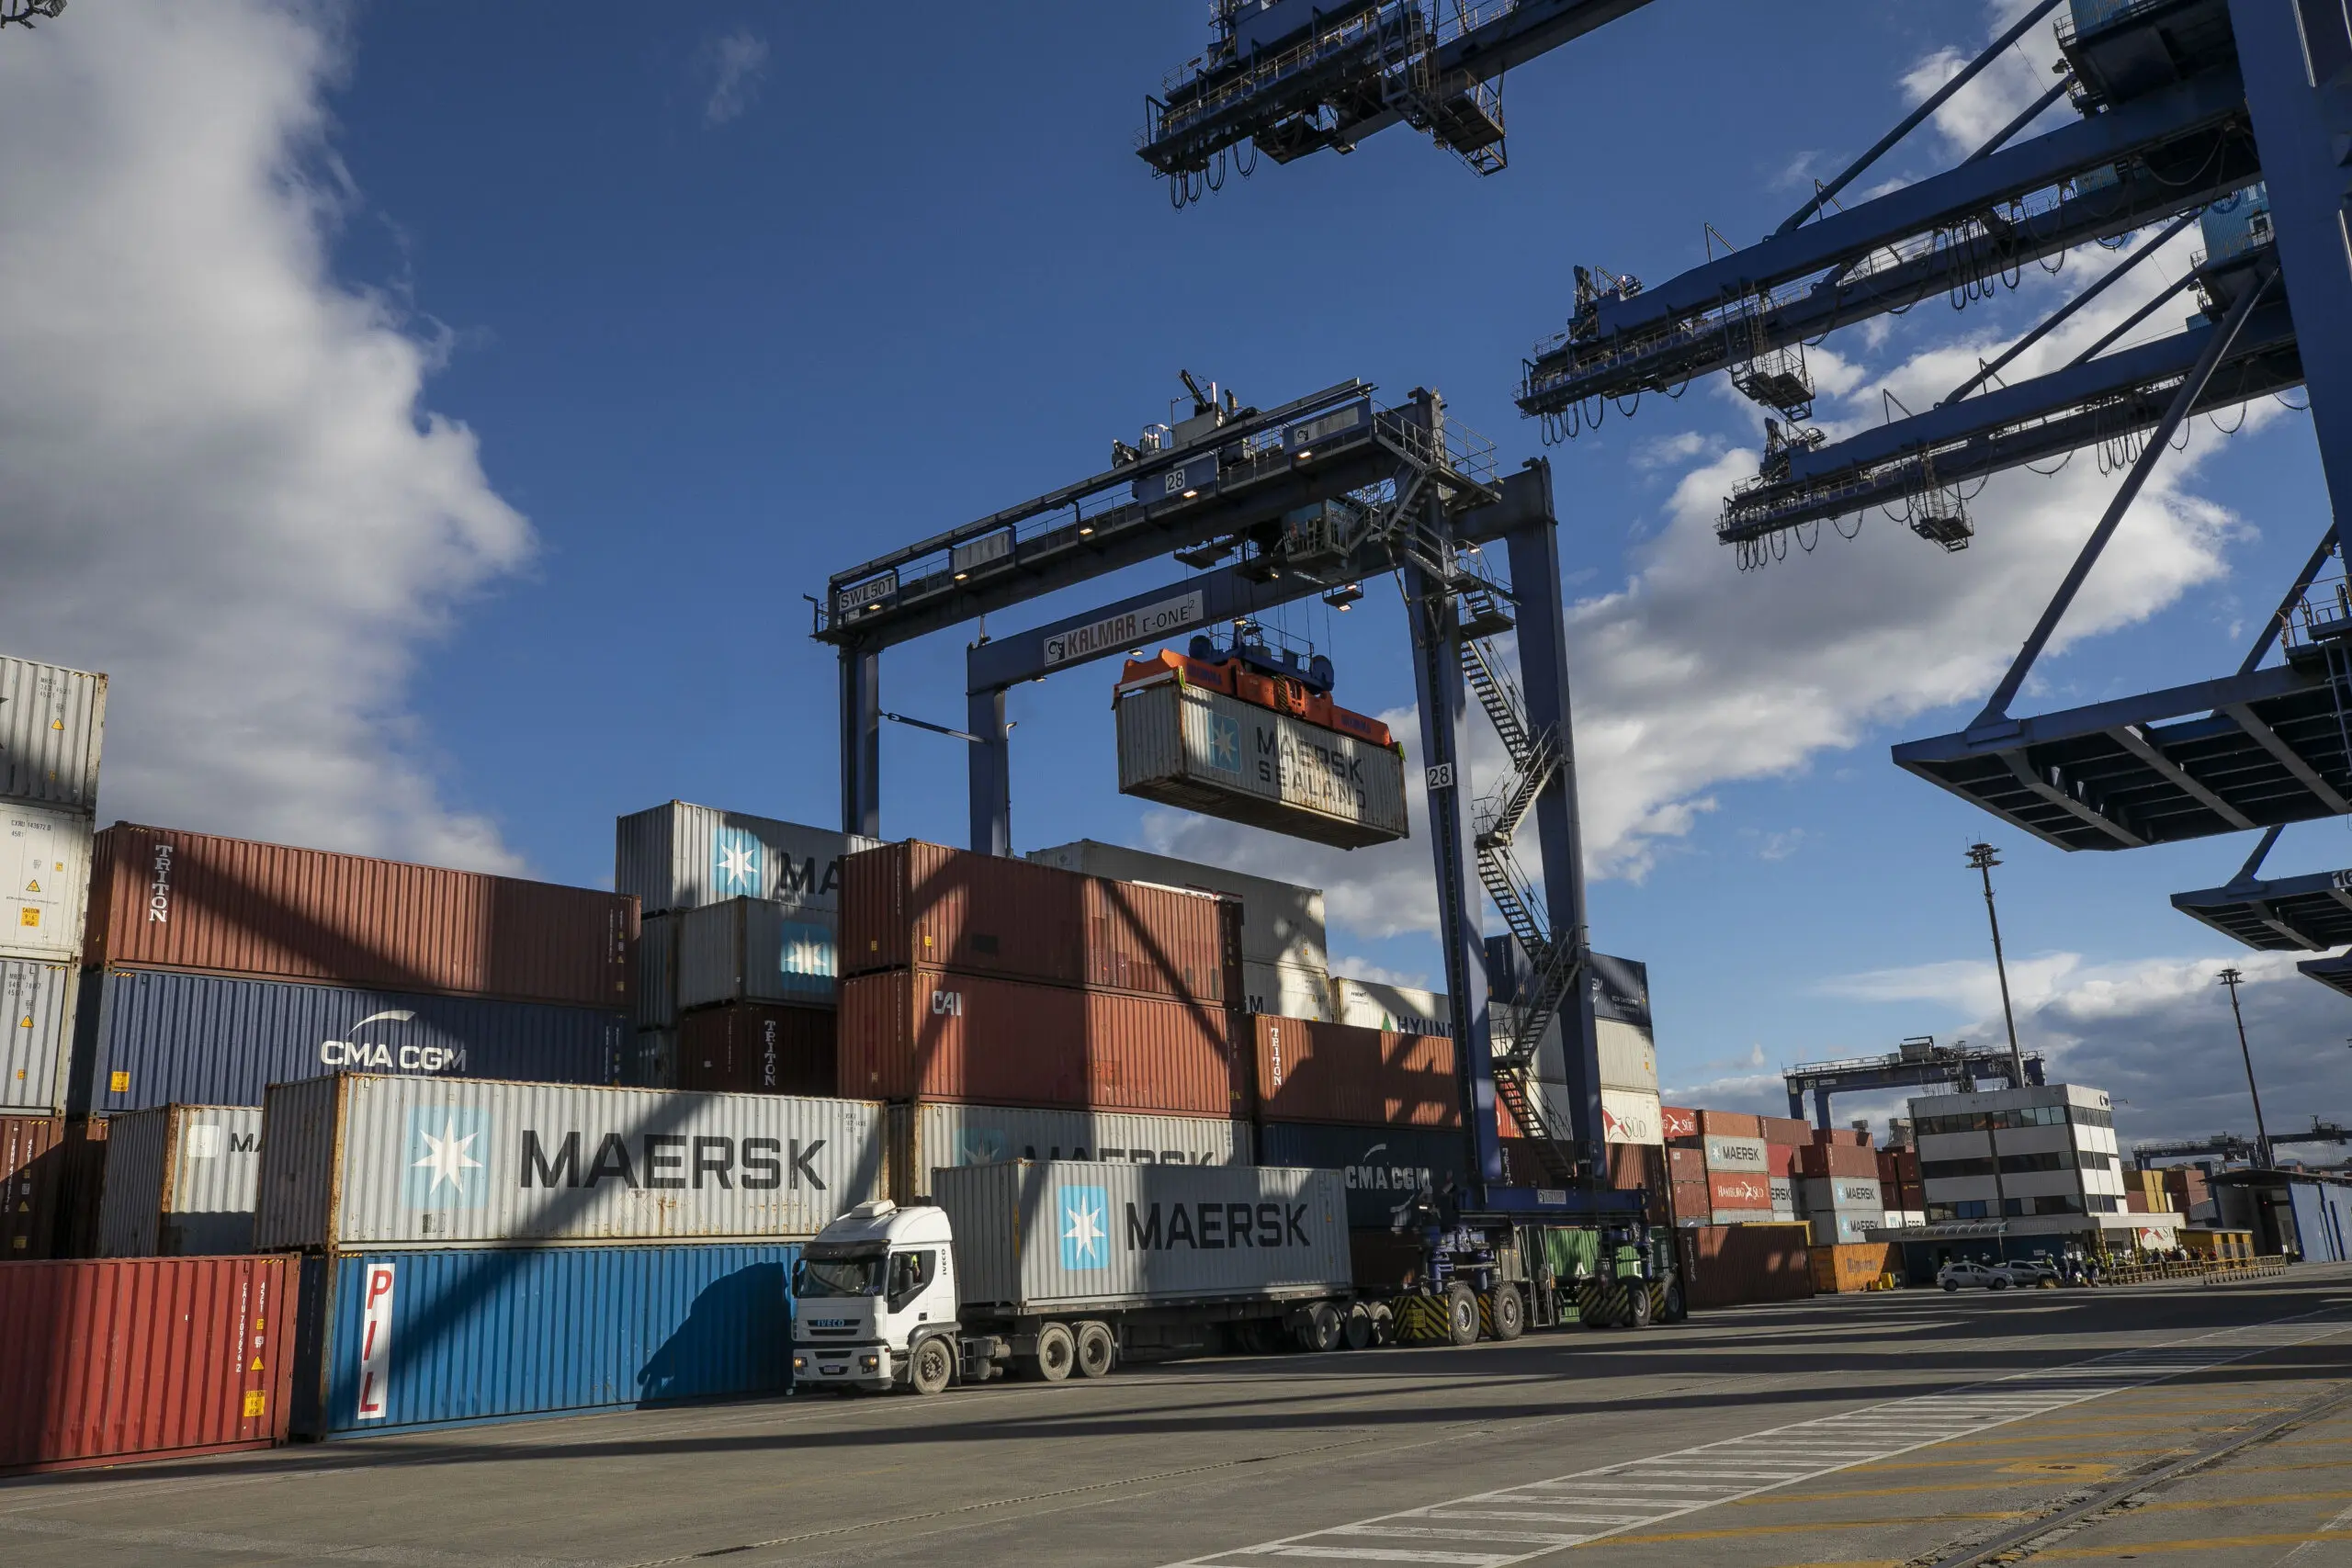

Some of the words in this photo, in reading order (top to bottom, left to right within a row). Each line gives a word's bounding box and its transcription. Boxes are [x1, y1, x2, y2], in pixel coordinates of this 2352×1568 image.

[1167, 471, 1184, 491] 28
[1067, 614, 1136, 658] KALMAR
[1256, 726, 1364, 785] MAERSK
[1258, 760, 1367, 810] SEALAND
[1429, 766, 1449, 787] 28
[150, 845, 174, 922] TRITON
[932, 990, 962, 1017] CAI
[321, 1041, 393, 1067] CMA
[399, 1045, 467, 1071] CGM
[764, 1020, 776, 1087] TRITON
[1270, 1027, 1283, 1087] TRITON
[1805, 1079, 1815, 1089] 12
[1626, 1116, 1647, 1138] SÜD
[520, 1129, 828, 1191] MAERSK
[1723, 1145, 1760, 1162] MAERSK
[1345, 1165, 1387, 1190] CMA
[1391, 1167, 1432, 1190] CGM
[1845, 1187, 1875, 1200] MAERSK
[1126, 1201, 1311, 1251] MAERSK
[817, 1318, 844, 1327] IVECO
[358, 1269, 393, 1413] PIL
